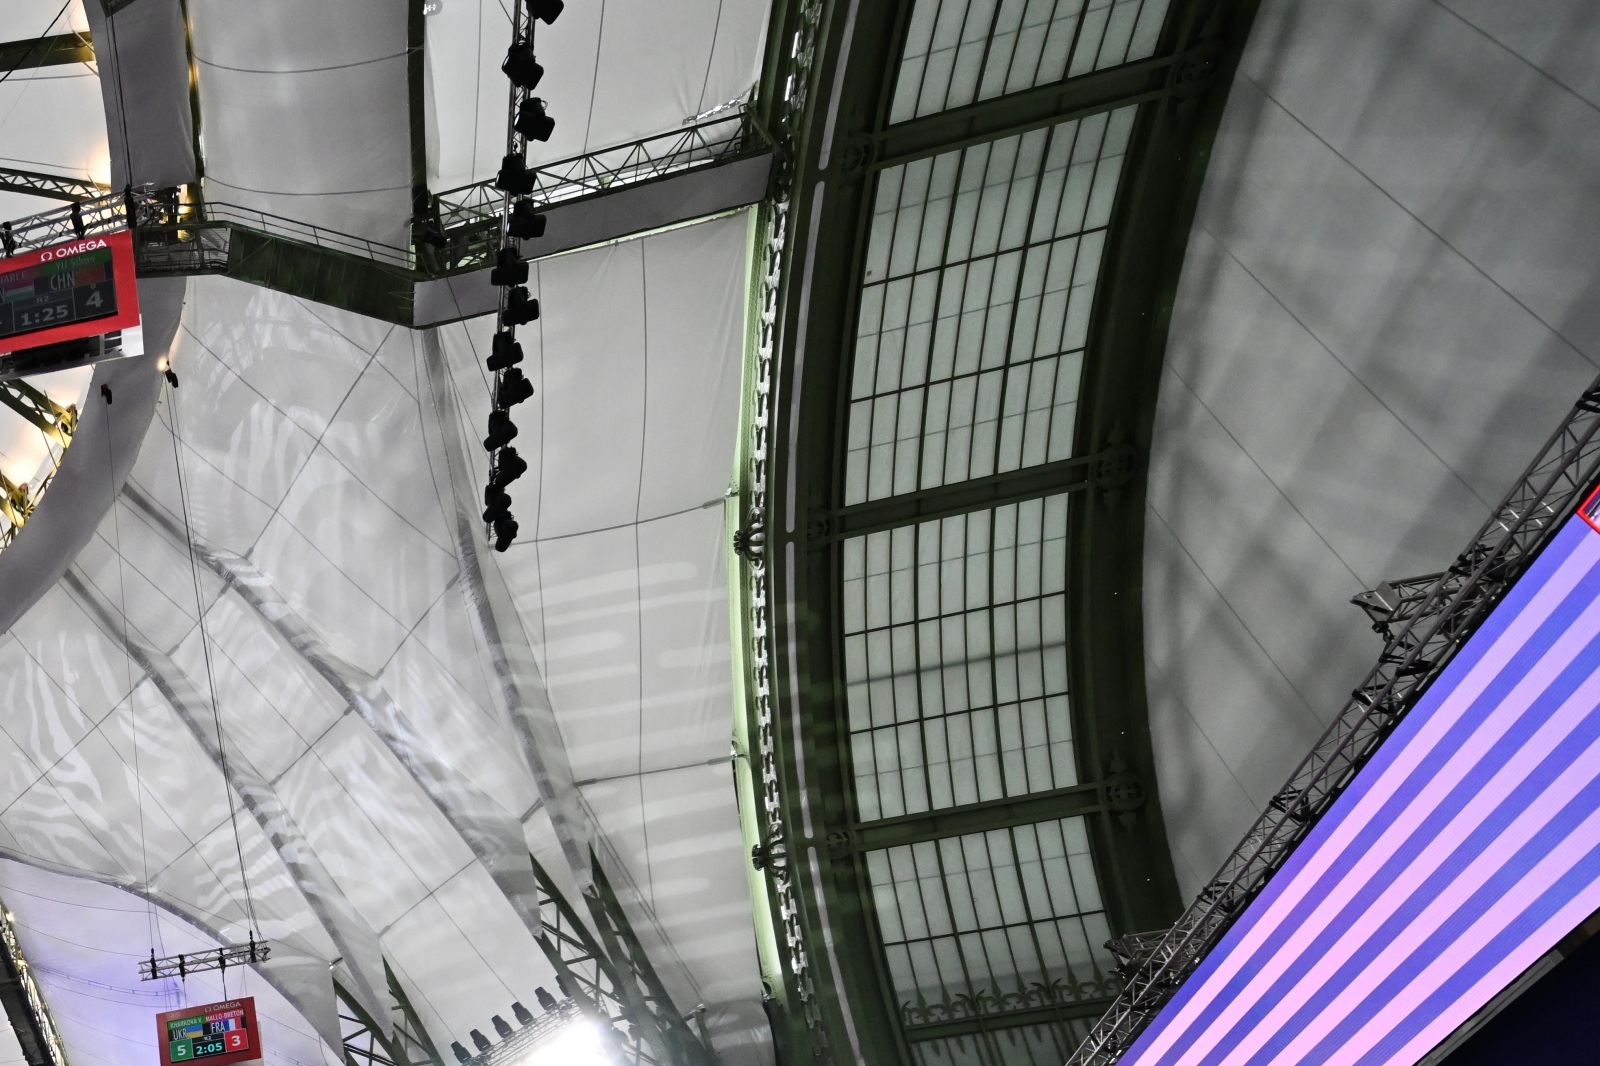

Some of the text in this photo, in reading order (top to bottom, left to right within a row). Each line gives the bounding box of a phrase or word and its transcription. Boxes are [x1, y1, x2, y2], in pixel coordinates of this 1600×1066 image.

[56, 239, 107, 258] OMEGA
[50, 271, 75, 290] CHN
[86, 290, 103, 308] 4
[21, 305, 69, 327] 1:25
[213, 1001, 241, 1011] OMEGA
[173, 1028, 187, 1040] UKR
[211, 1021, 226, 1034] FRA
[231, 1036, 241, 1046] 3
[177, 1045, 186, 1056] 5
[196, 1042, 223, 1055] 2:05
